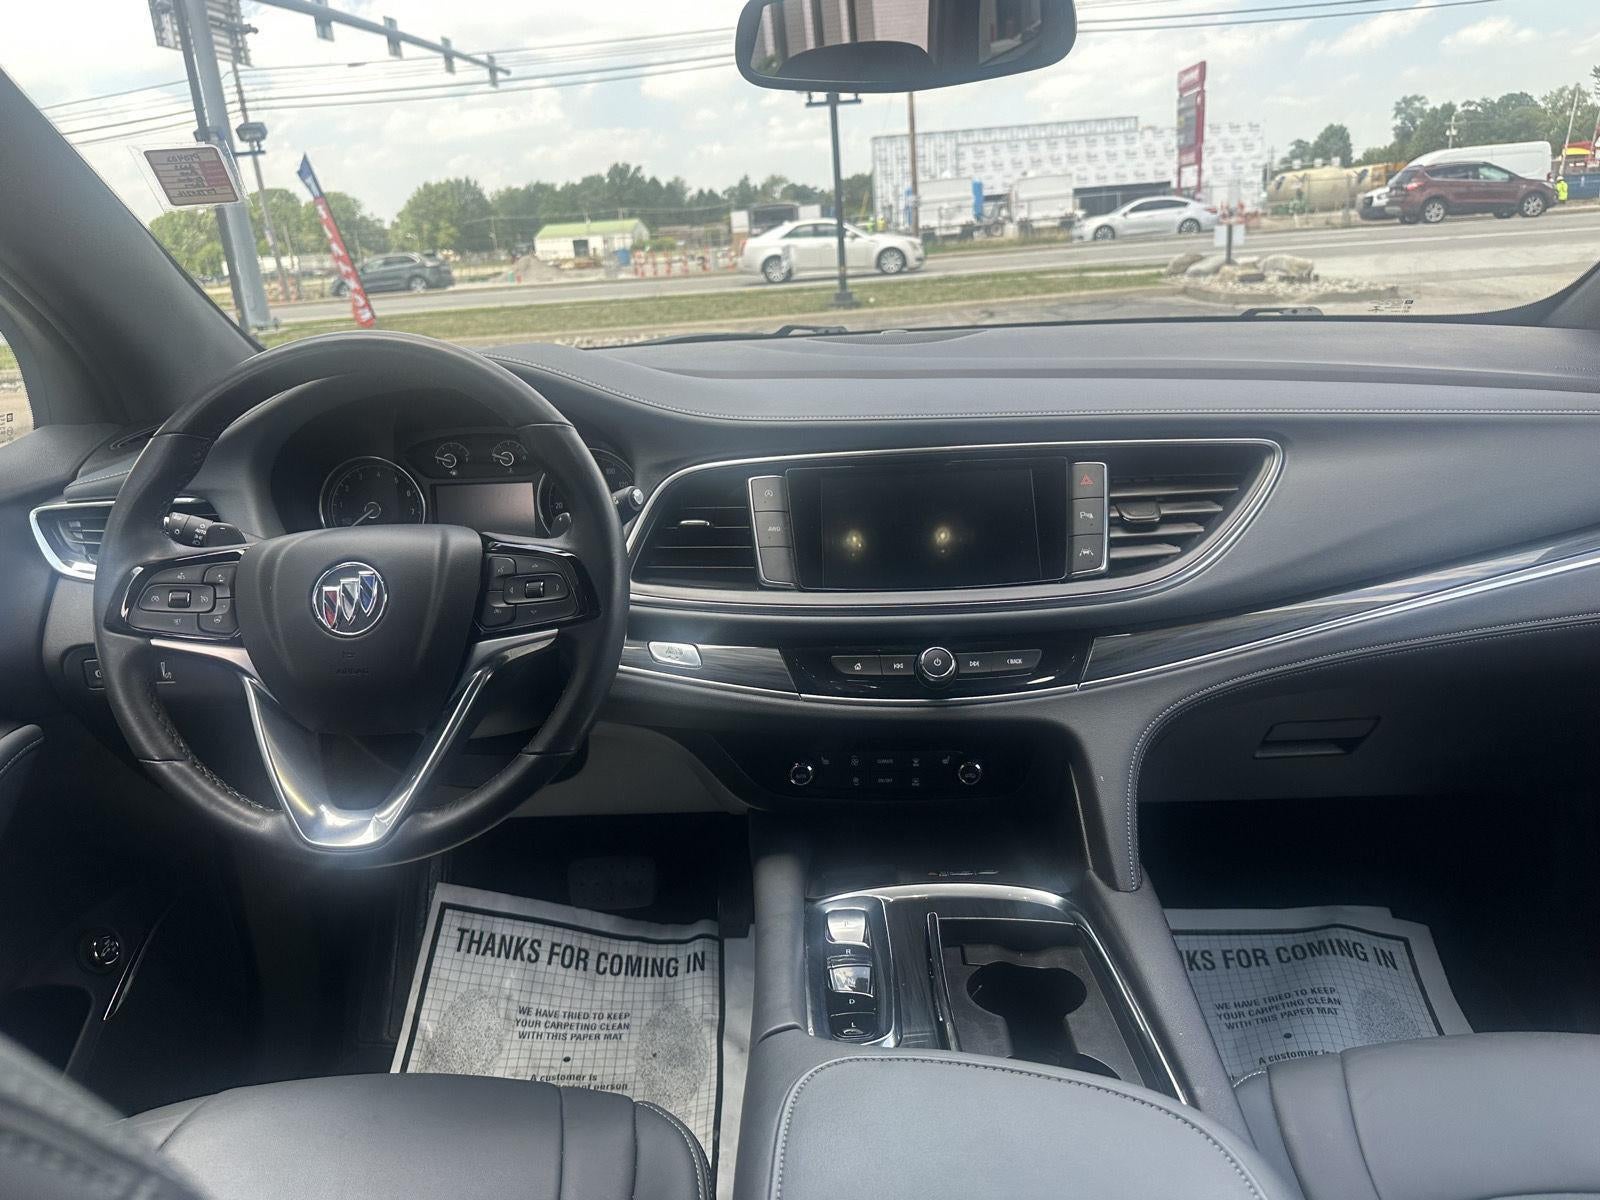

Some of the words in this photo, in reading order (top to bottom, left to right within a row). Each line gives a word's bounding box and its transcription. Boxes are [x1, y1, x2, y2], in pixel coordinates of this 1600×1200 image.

[457, 927, 542, 963] THANKS
[547, 942, 590, 971] FOR
[595, 952, 679, 978] COMING
[686, 951, 705, 974] IN
[1221, 948, 1270, 970] FOR
[1275, 938, 1369, 964] COMING
[1373, 946, 1398, 971] IN
[1215, 1002, 1231, 1011] WE
[1233, 998, 1261, 1009] HAVE
[1263, 992, 1291, 1004] TRIED
[1294, 988, 1308, 997] TO
[1310, 986, 1336, 995] KEEP
[518, 1006, 533, 1016] WE
[535, 1008, 560, 1019] HAVE
[562, 1010, 590, 1020] TRIED
[592, 1012, 605, 1020] TO
[606, 1012, 631, 1020] KEEP
[1216, 1010, 1246, 1021] YOUR
[1248, 998, 1305, 1017] CARPETING
[1307, 996, 1341, 1006] CLEAN
[515, 1018, 541, 1028] YOUR
[544, 1019, 597, 1031] CARPETING
[599, 1022, 631, 1031] CLEAN
[1224, 1019, 1252, 1030] WITH
[1255, 1013, 1278, 1025] THIS
[1280, 1007, 1314, 1019] PAPER
[1316, 1006, 1340, 1016] MAT
[518, 1031, 543, 1040] WITH
[546, 1032, 568, 1041] THIS
[570, 1032, 601, 1041] PAPER
[603, 1032, 625, 1041] MAT
[1258, 1056, 1266, 1065] A
[1268, 1049, 1318, 1062] customer
[530, 1073, 538, 1082] A
[540, 1073, 586, 1081] customer
[588, 1073, 598, 1081] is
[594, 1083, 628, 1091] person
